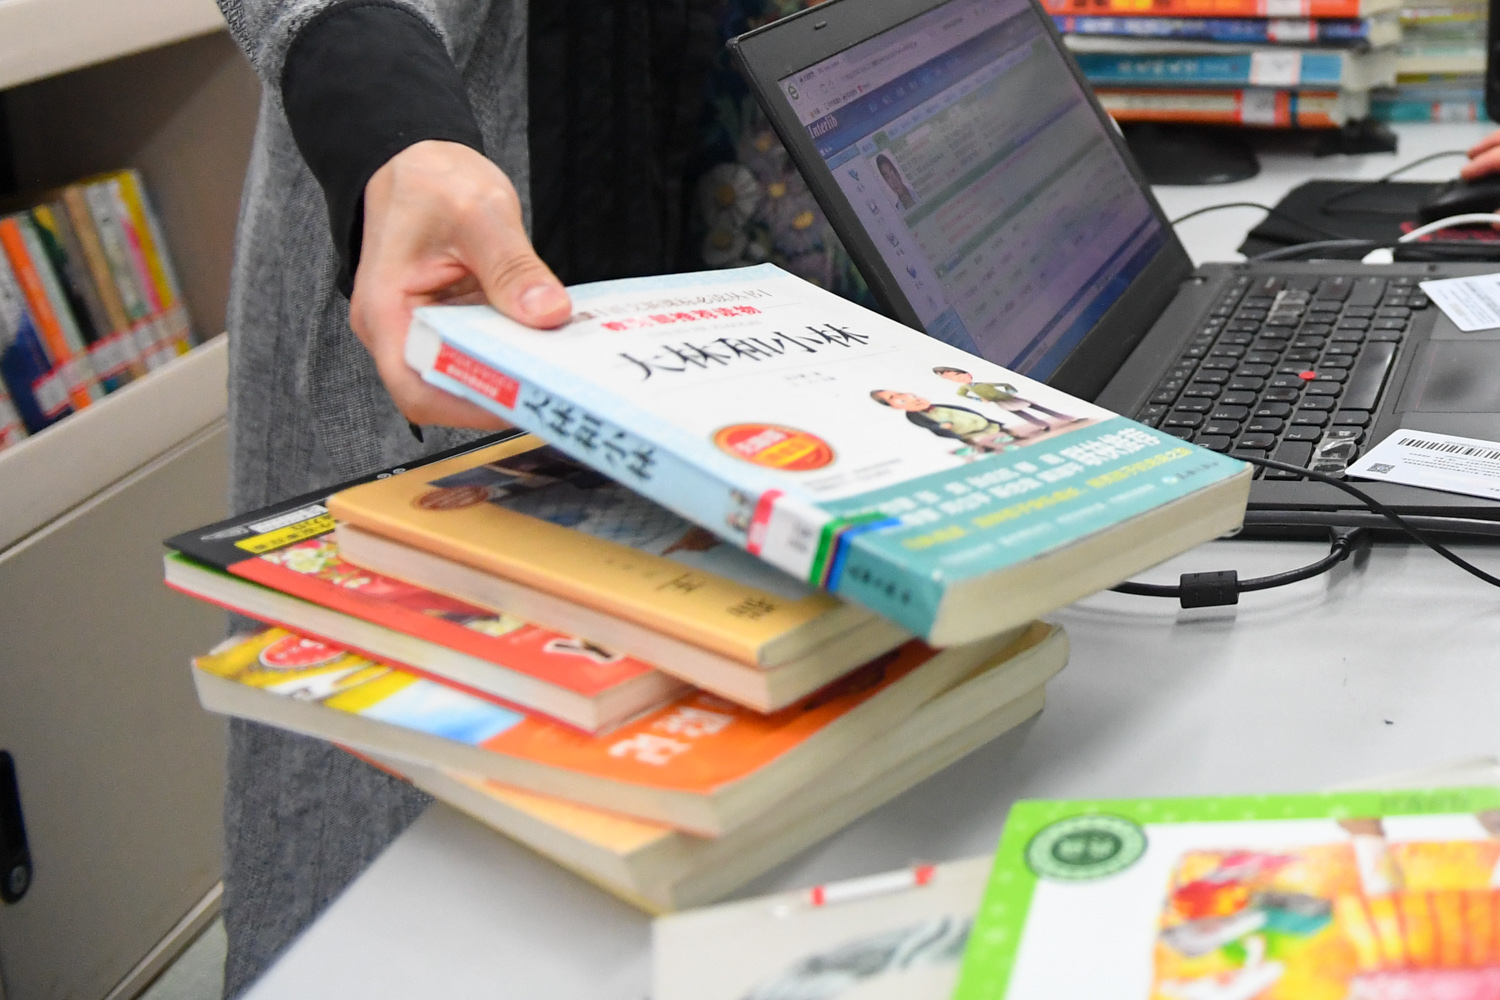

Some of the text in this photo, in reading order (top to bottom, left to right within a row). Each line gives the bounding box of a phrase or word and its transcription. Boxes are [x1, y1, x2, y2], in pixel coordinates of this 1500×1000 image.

[807, 113, 839, 140] Interlib
[618, 323, 869, 381] 大林和小林
